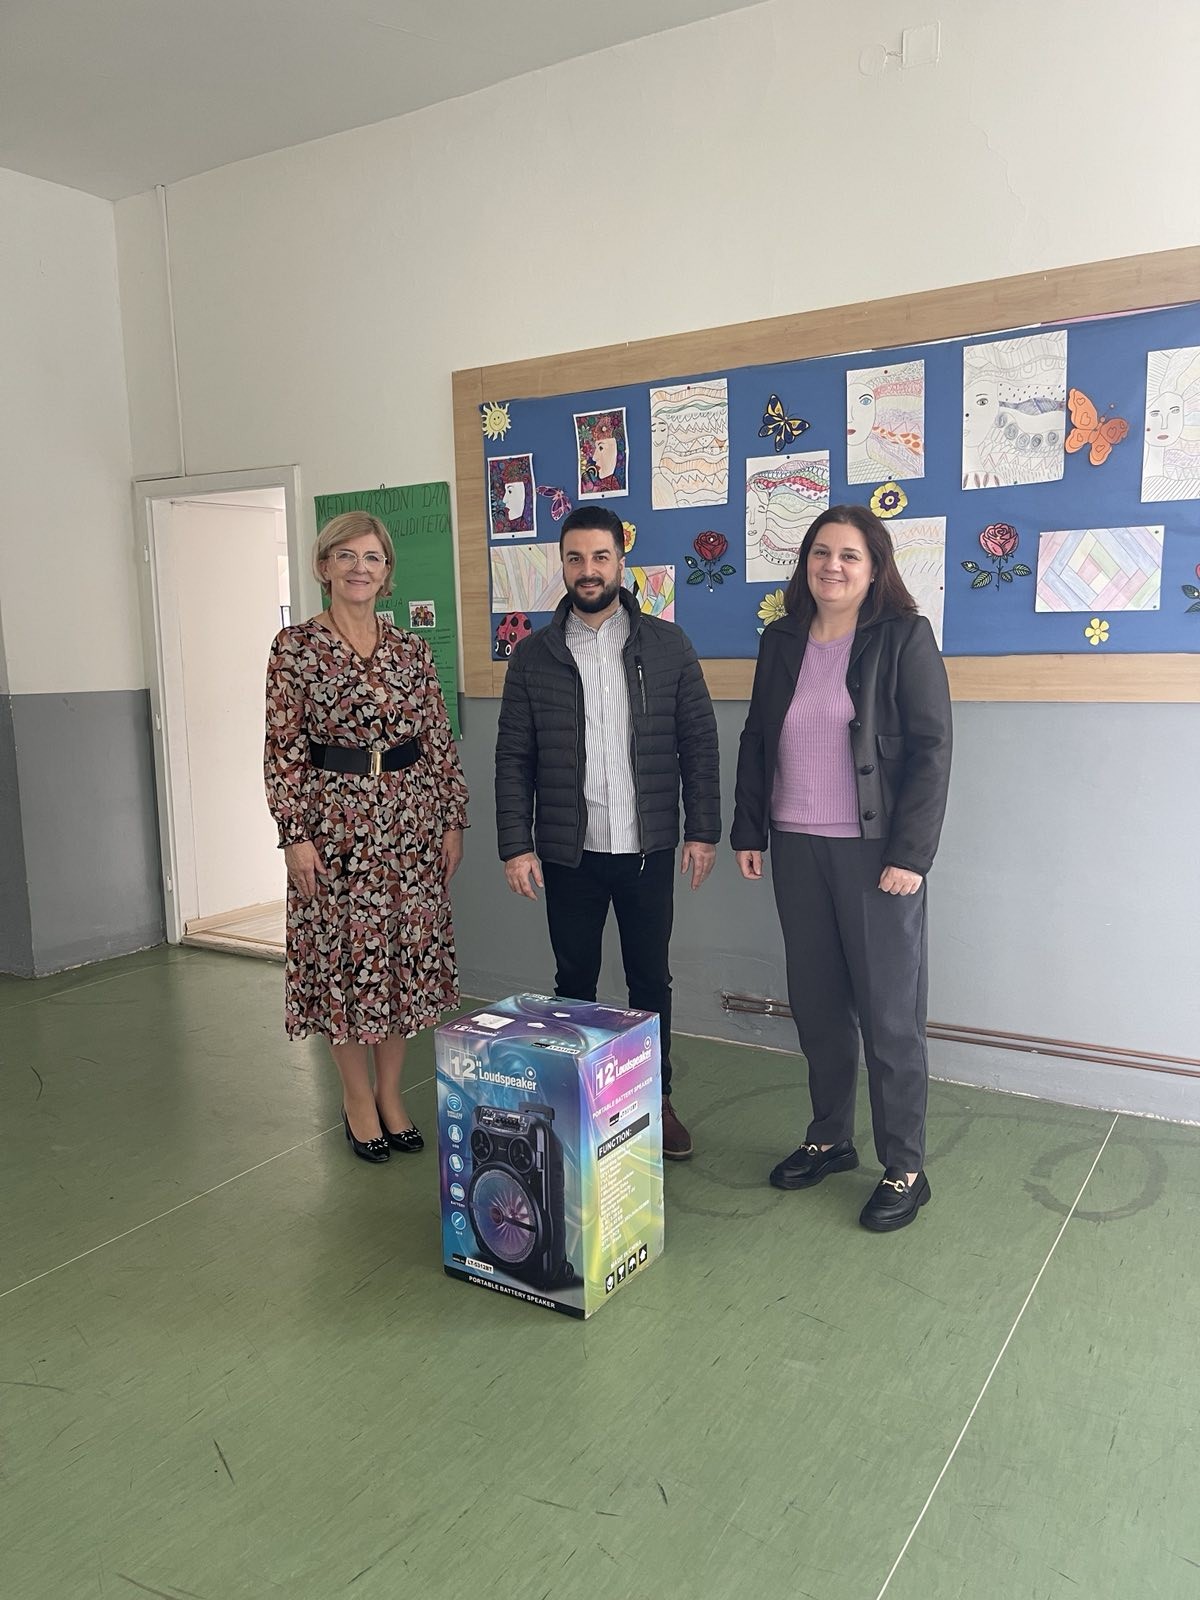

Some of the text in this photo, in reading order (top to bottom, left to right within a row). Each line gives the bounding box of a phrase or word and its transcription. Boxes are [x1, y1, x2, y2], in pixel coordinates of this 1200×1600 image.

[422, 485, 449, 508] DAN
[451, 1056, 537, 1091] 12" Loudspeaker
[616, 1049, 652, 1077] Loudspeaker
[469, 1276, 555, 1309] PORTABLE BATTERY SPEAKER
